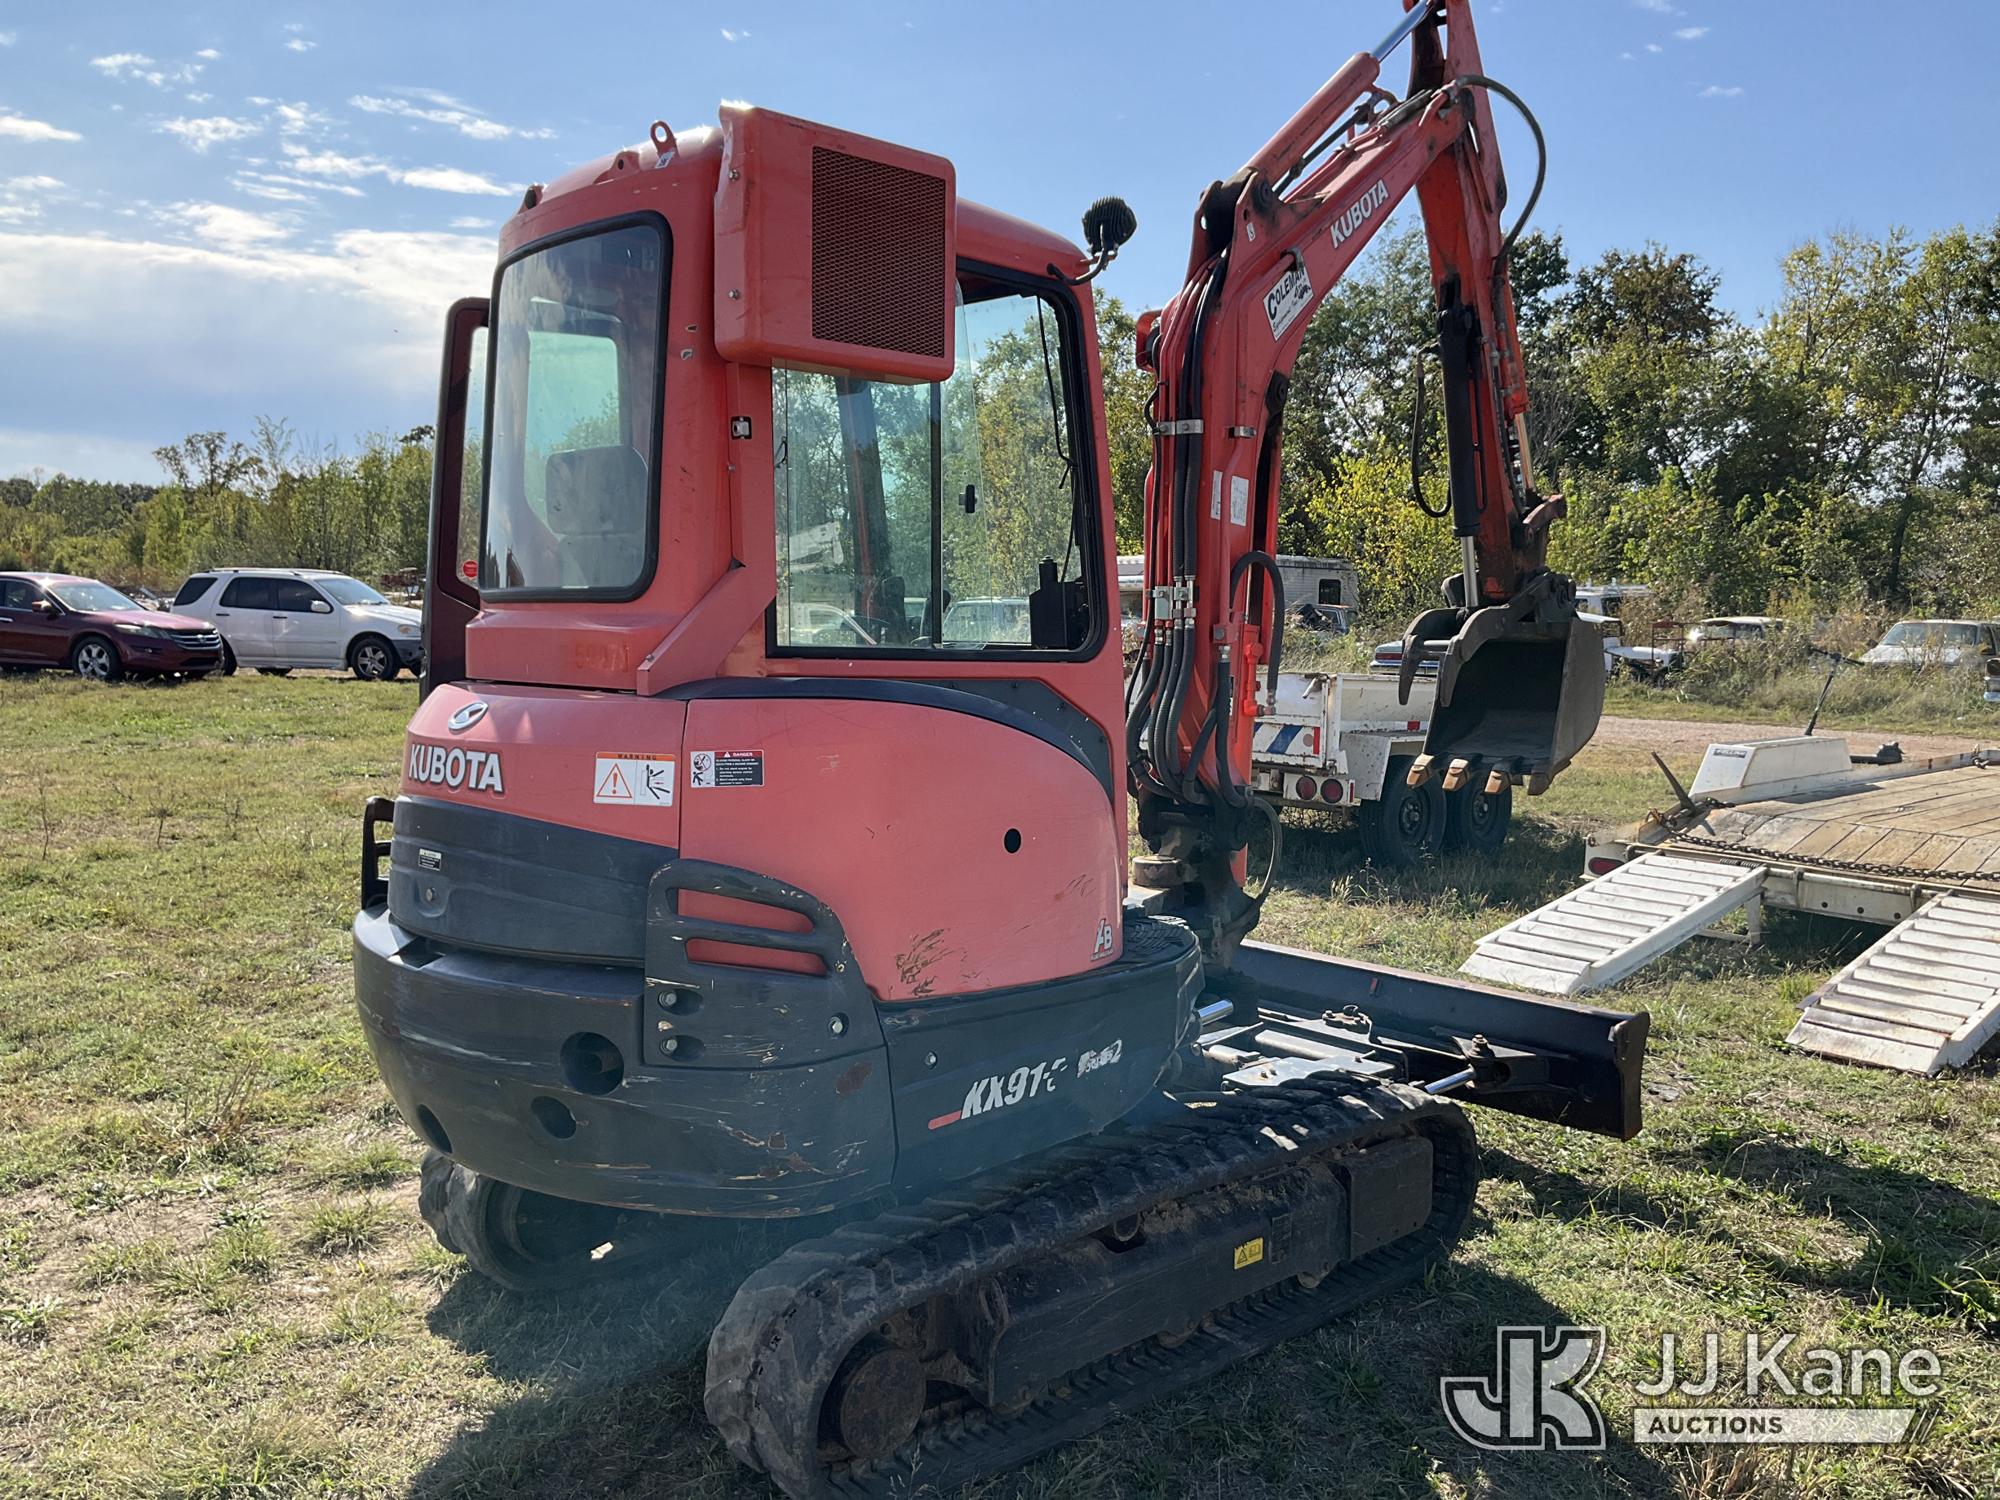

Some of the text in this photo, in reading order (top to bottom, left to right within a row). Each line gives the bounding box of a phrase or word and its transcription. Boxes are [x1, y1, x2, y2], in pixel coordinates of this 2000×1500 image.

[1329, 178, 1389, 249] KUBOTA
[408, 743, 503, 792] KUBOTA
[617, 753, 657, 761] WARNING
